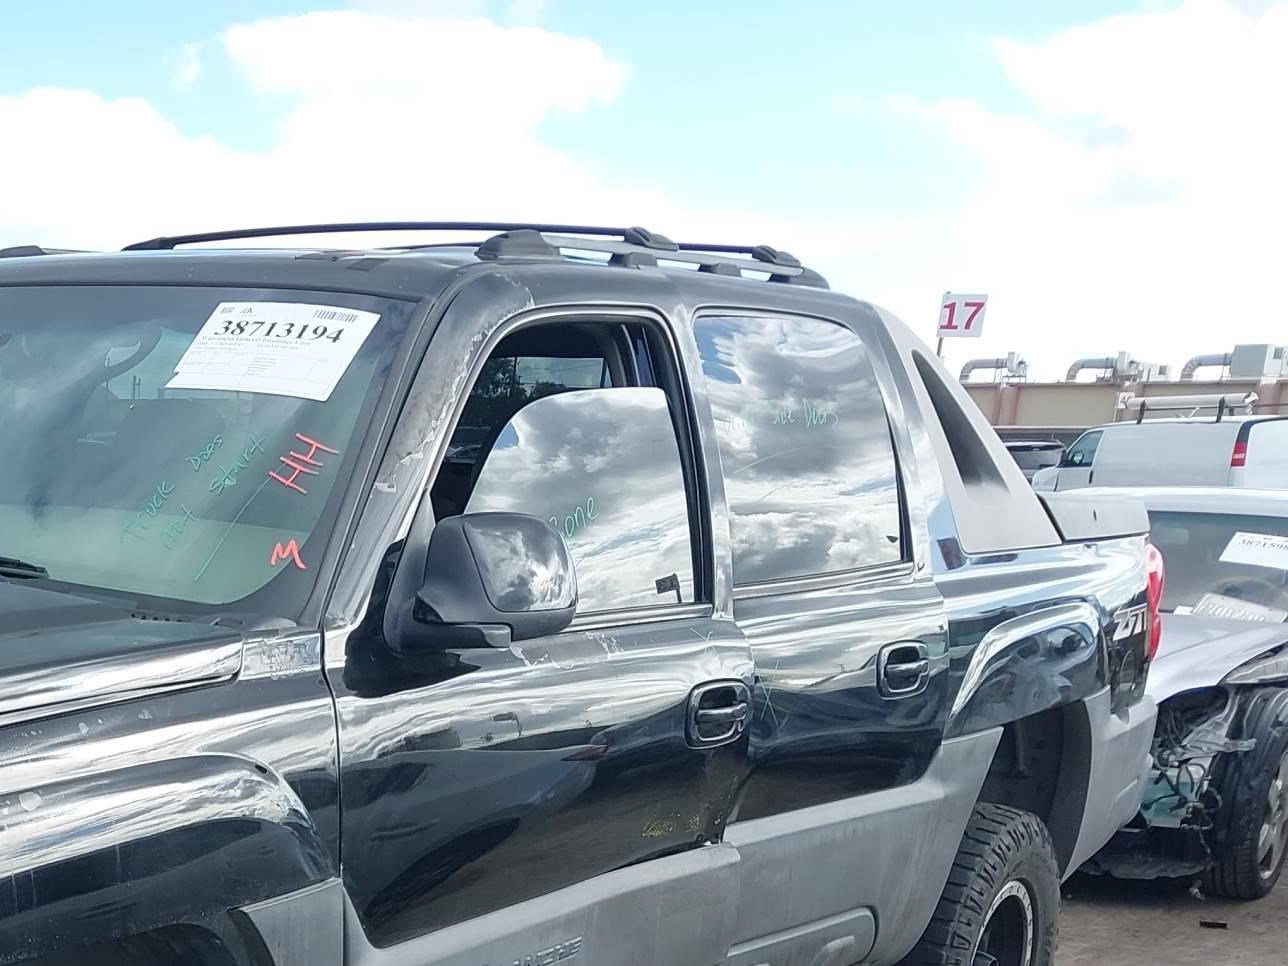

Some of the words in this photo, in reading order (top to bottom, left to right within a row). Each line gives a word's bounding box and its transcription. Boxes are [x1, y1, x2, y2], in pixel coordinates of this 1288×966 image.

[939, 302, 985, 330] 17
[213, 319, 345, 343] 38713194
[1112, 602, 1149, 642] Z71
